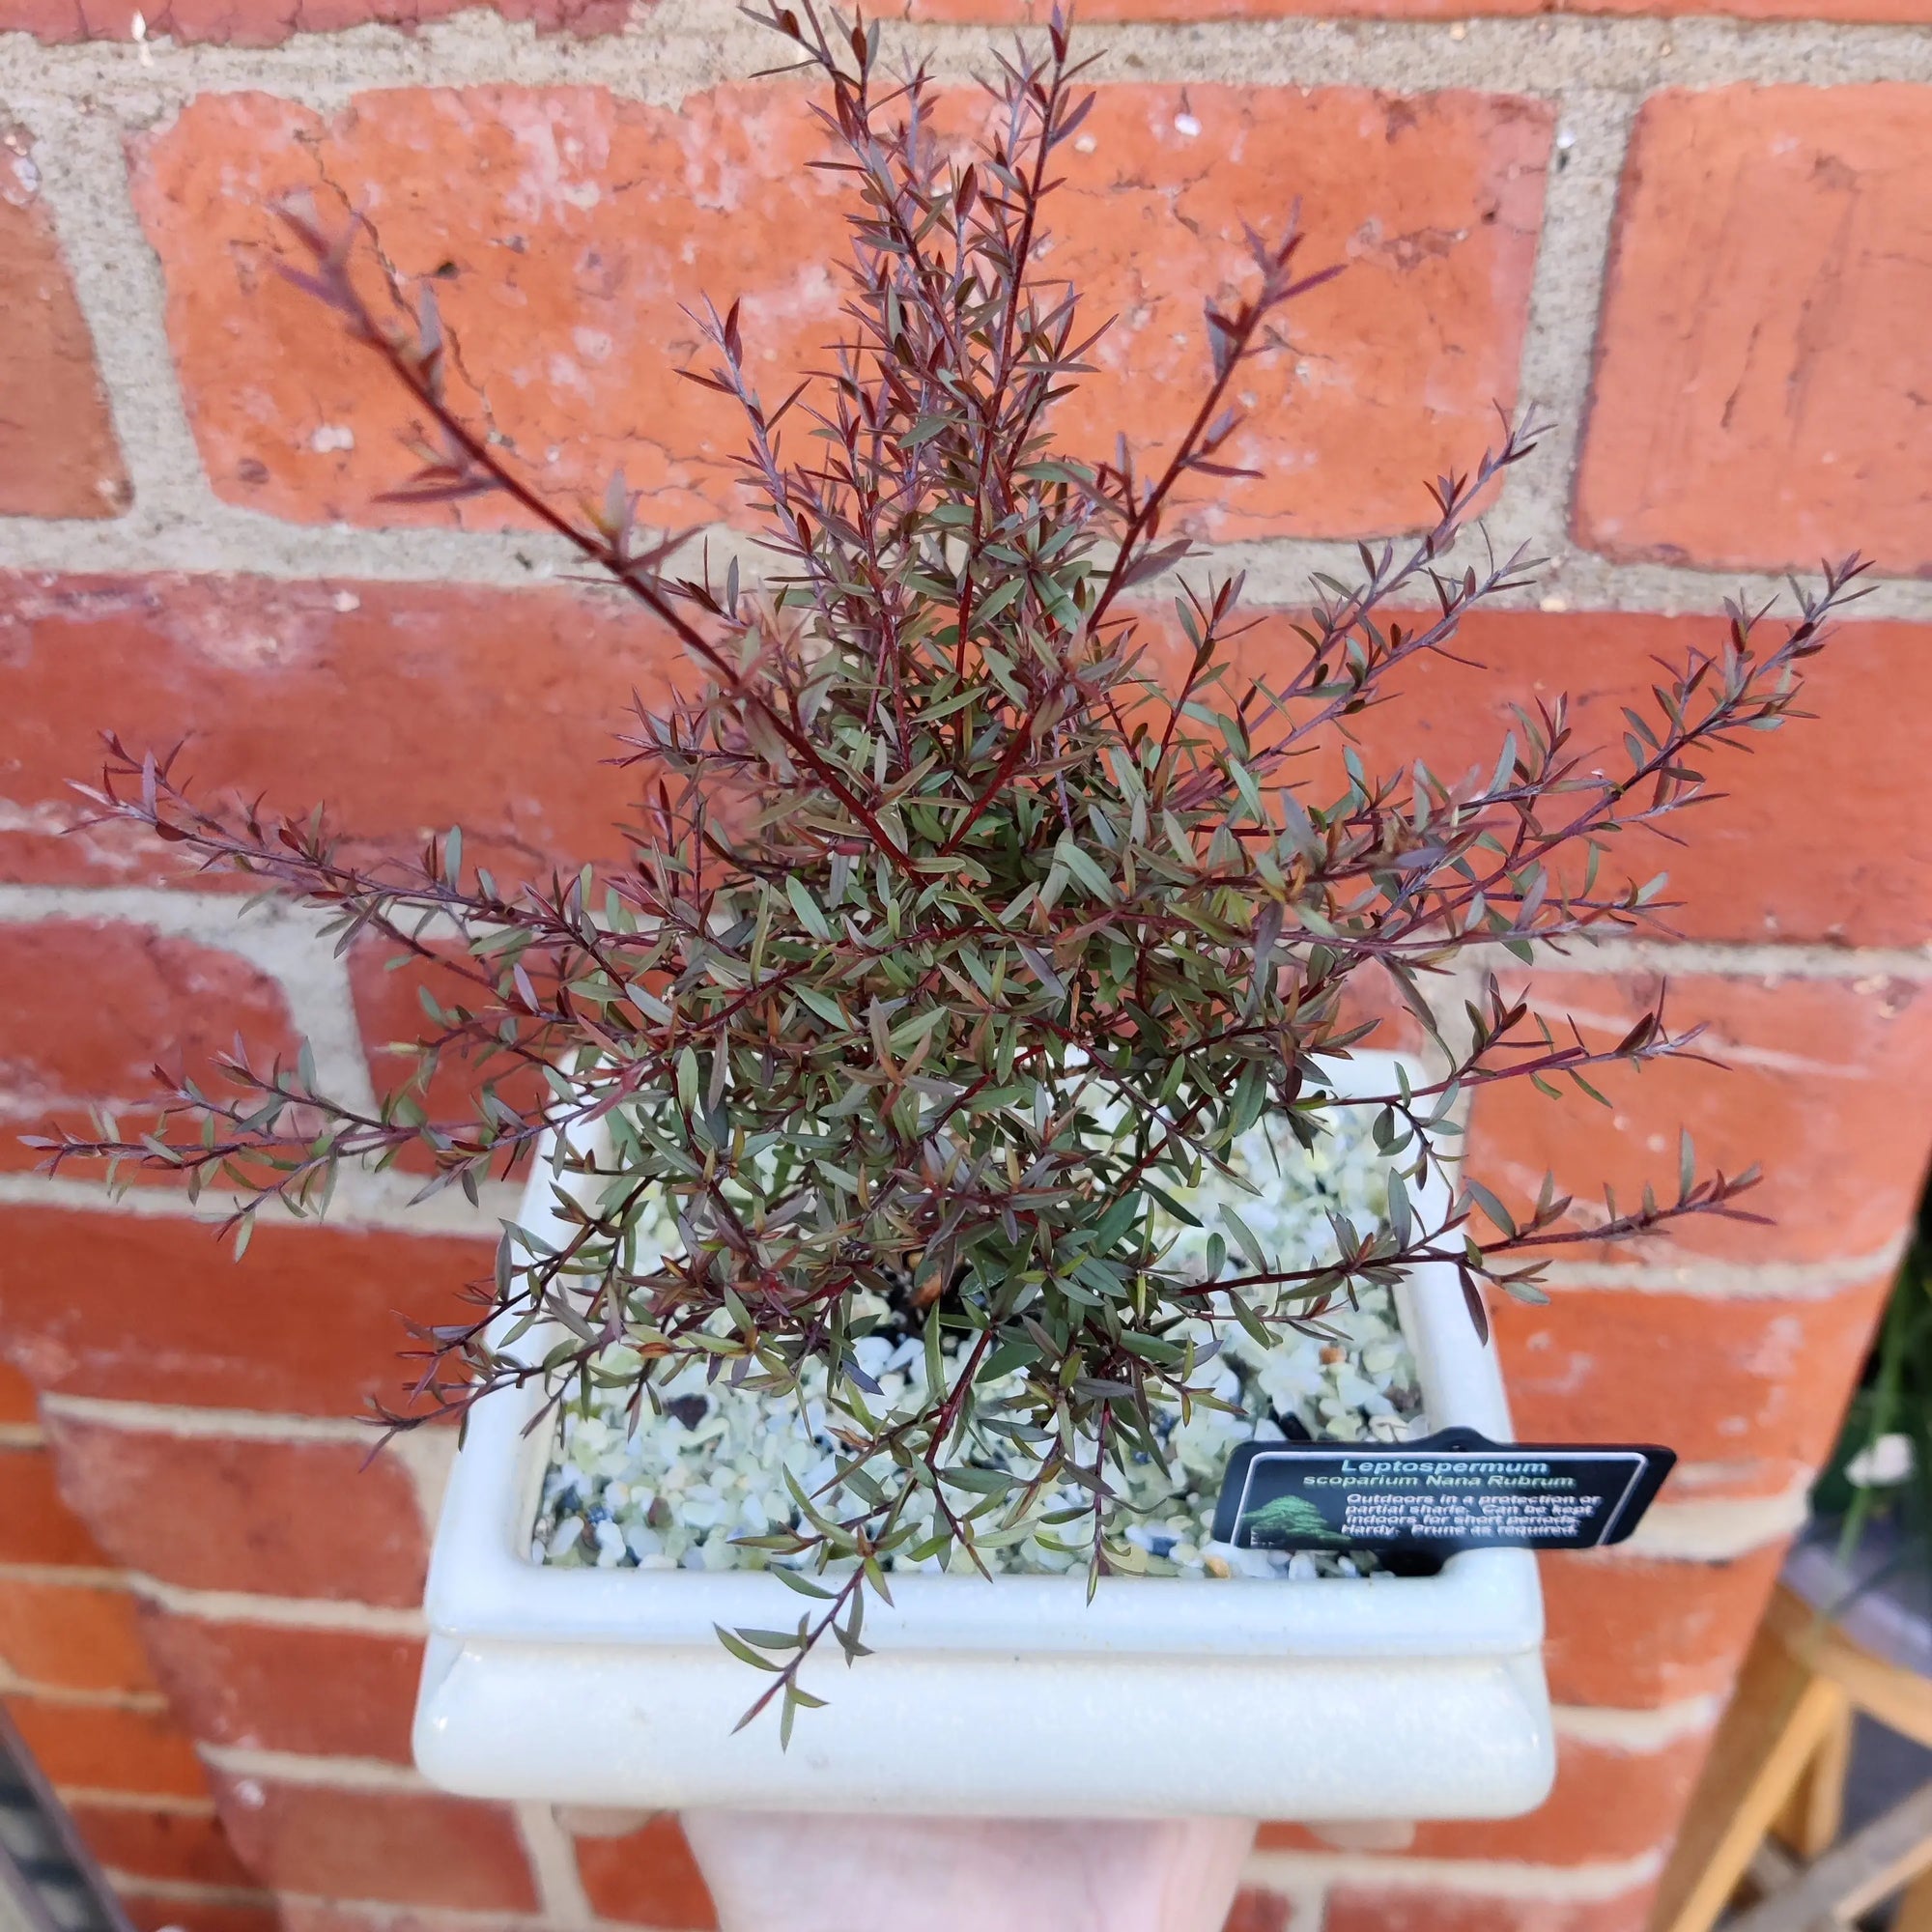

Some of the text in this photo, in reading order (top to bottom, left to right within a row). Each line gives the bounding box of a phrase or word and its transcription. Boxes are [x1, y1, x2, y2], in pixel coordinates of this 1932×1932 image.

[1342, 1459, 1548, 1474] Leptospermum
[1303, 1474, 1575, 1488] scoparium Nana Rubrum
[1347, 1493, 1435, 1505] Outdoors
[1440, 1494, 1458, 1504] in
[1346, 1504, 1405, 1516] partial
[1483, 1504, 1520, 1515] Can
[1523, 1504, 1548, 1515] be
[1423, 1515, 1449, 1525] for
